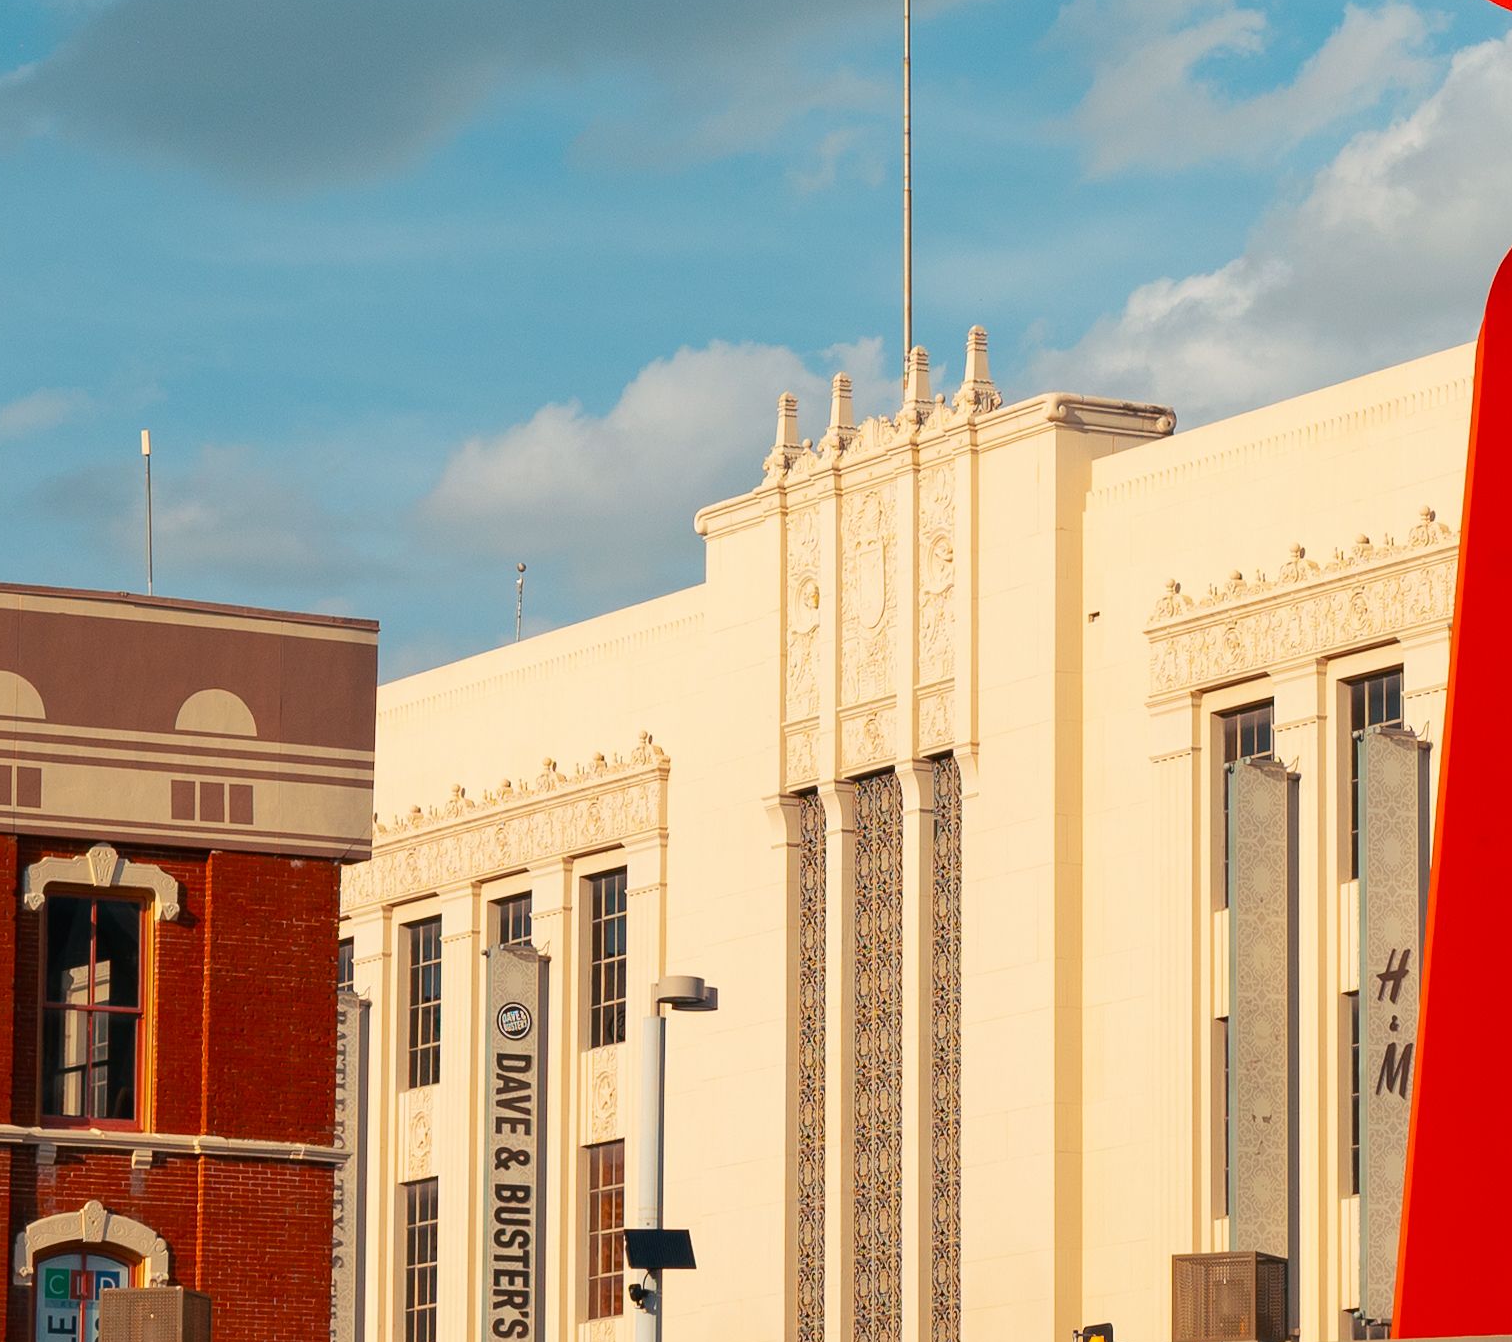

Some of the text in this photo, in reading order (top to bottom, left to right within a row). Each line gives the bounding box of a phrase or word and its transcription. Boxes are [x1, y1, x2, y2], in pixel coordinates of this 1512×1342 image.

[492, 1053, 532, 1339] DAVE & BUSTER'S
